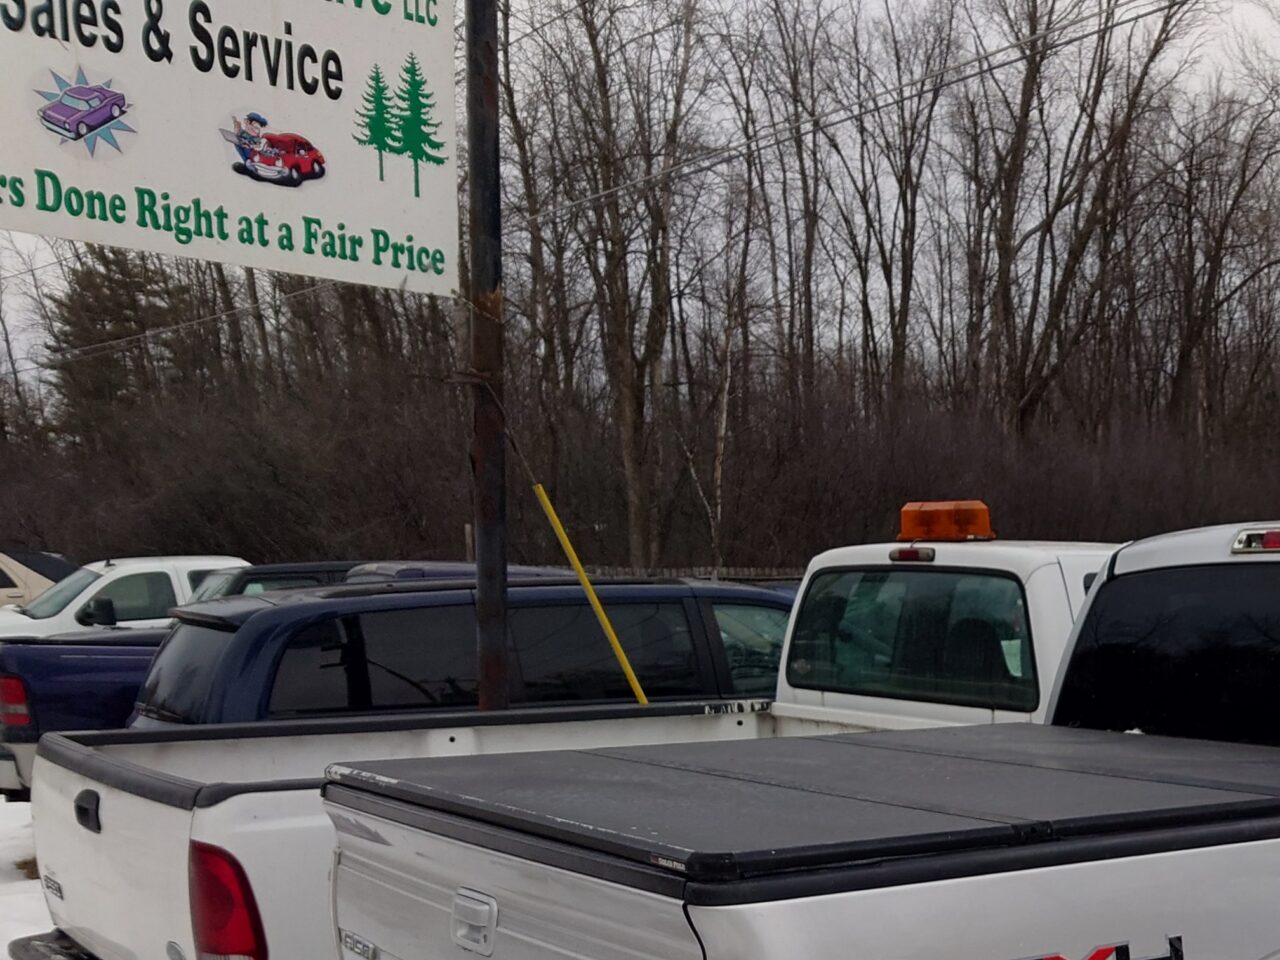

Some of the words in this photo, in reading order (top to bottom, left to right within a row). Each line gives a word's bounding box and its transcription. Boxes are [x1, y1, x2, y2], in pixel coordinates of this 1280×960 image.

[142, 0, 173, 64] &
[189, 0, 344, 100] Service
[403, 0, 438, 27] LLC
[34, 168, 126, 224] Done
[135, 186, 229, 244] Right
[237, 215, 270, 248] at
[278, 222, 294, 251] a
[302, 216, 363, 262] Fair
[371, 229, 446, 275] Price
